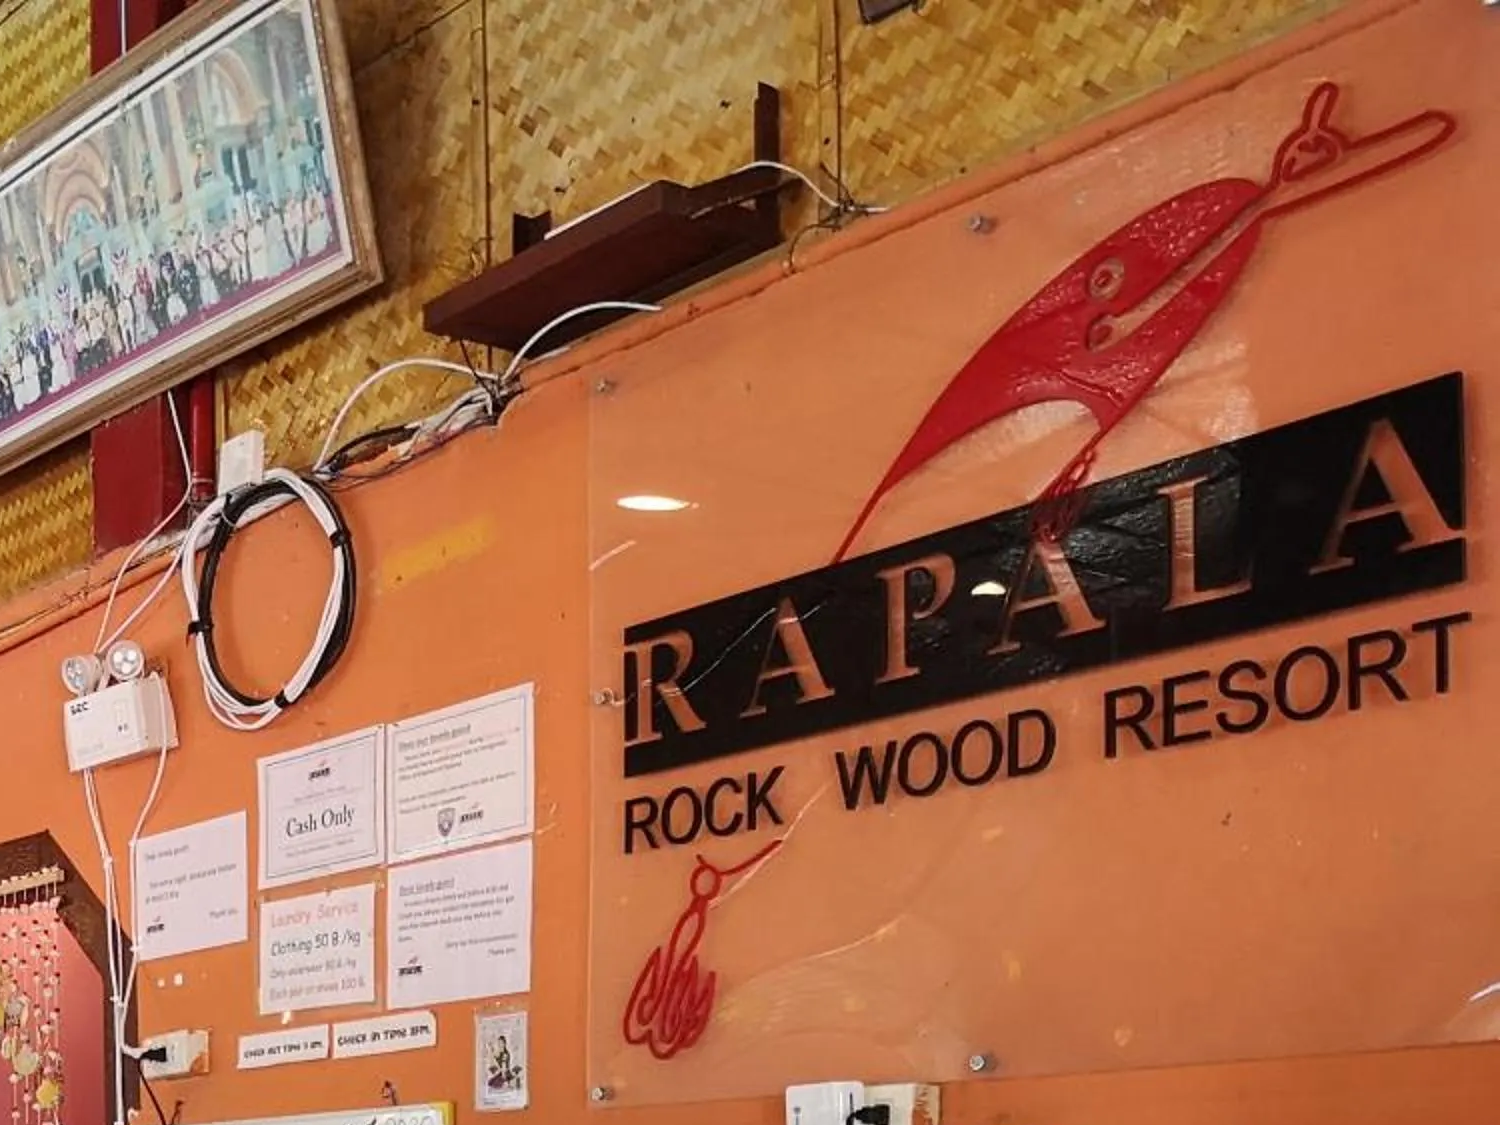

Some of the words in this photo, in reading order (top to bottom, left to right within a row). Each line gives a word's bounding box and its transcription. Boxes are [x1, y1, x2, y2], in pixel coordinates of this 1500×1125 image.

[626, 418, 1463, 745] RAPALA
[623, 766, 786, 855] ROCK
[835, 708, 1057, 811] WOOD
[1104, 612, 1472, 759] RESORT
[285, 813, 317, 838] Cash
[320, 803, 355, 828] Only
[315, 933, 329, 950] 50
